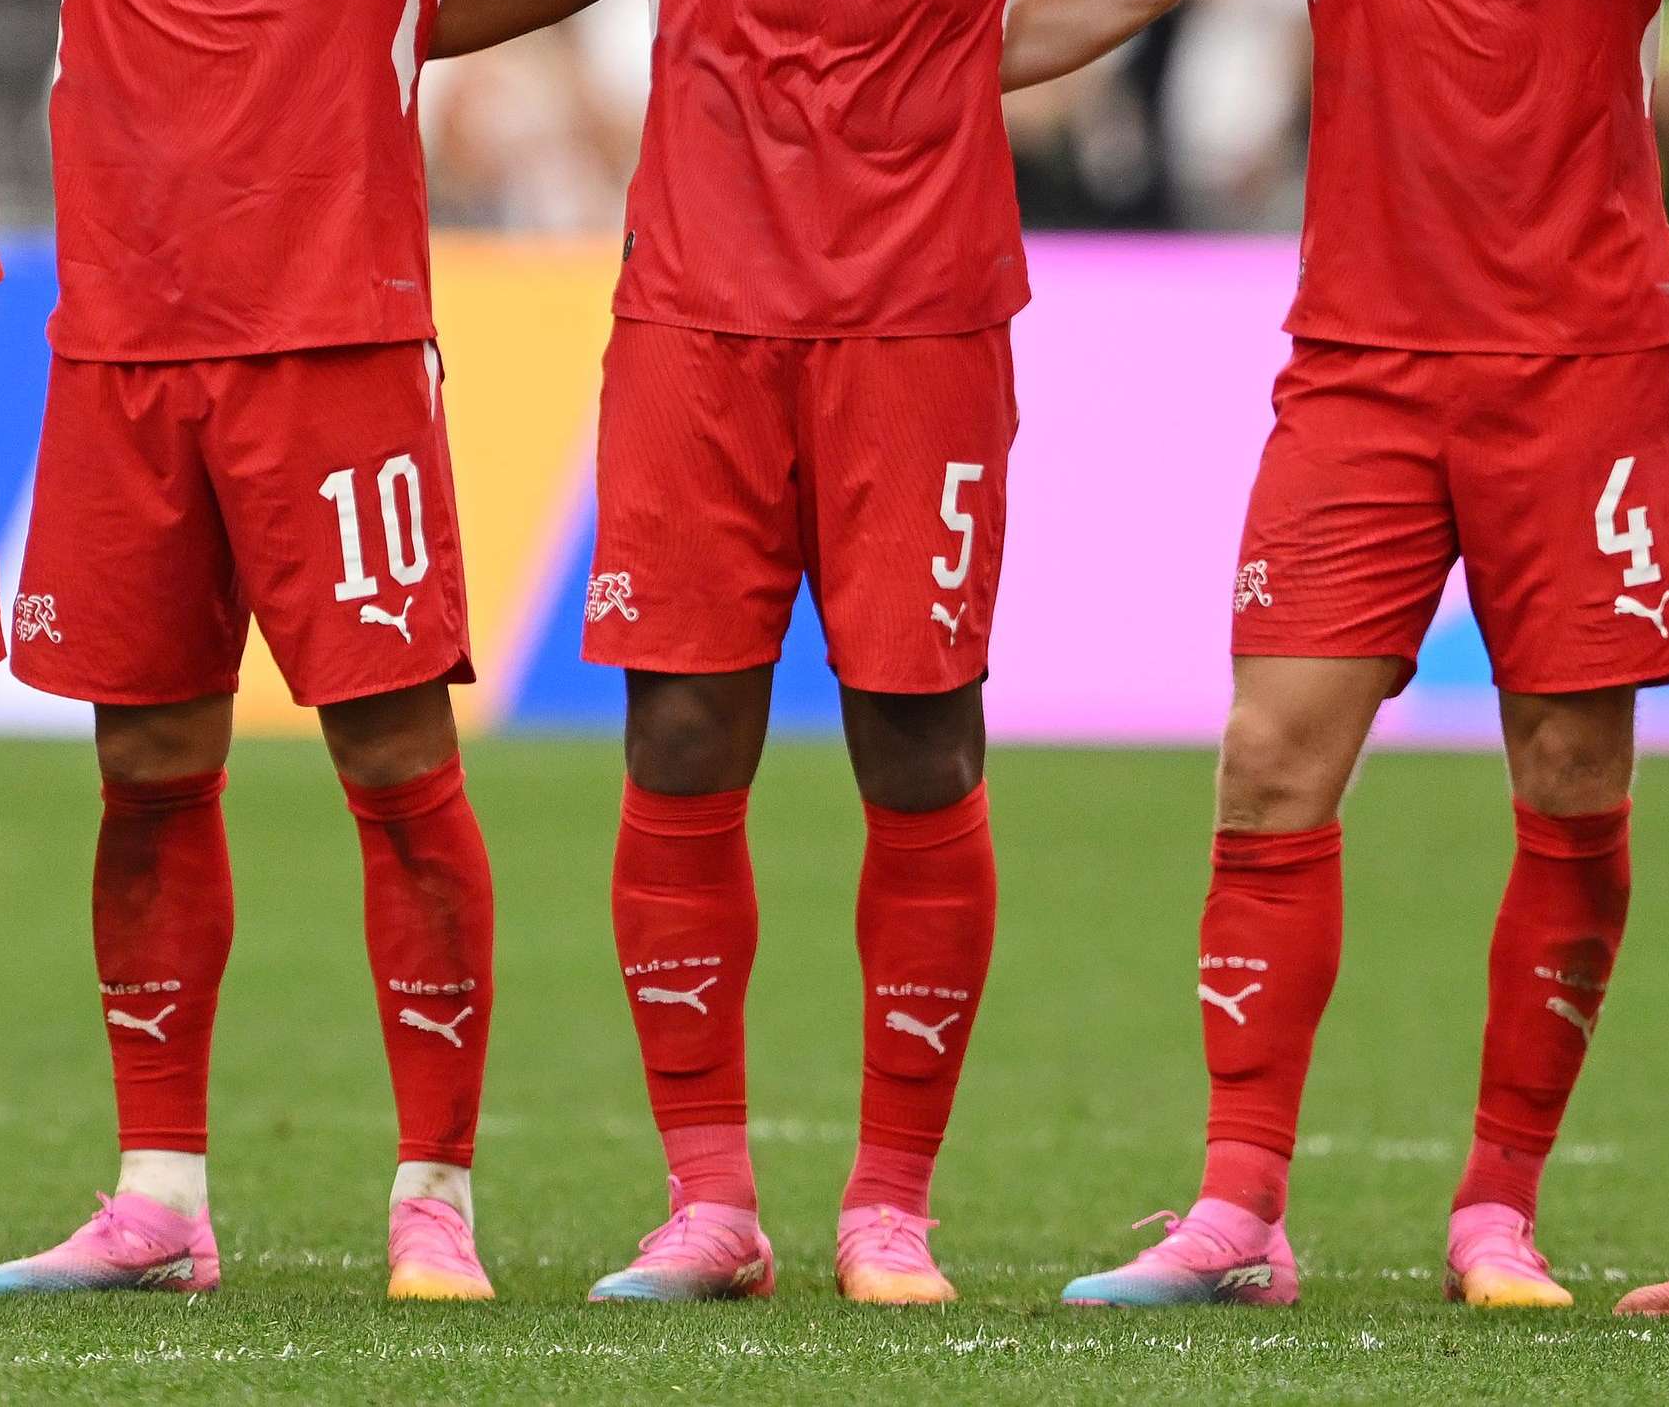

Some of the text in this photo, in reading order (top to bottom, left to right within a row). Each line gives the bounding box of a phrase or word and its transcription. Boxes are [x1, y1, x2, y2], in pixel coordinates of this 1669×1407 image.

[318, 453, 429, 602] 10
[931, 461, 984, 589] 5
[1594, 456, 1662, 588] 4
[625, 956, 721, 977] suisse
[1198, 953, 1269, 972] uisse
[388, 978, 476, 996] suisse
[876, 981, 969, 1004] suisse
